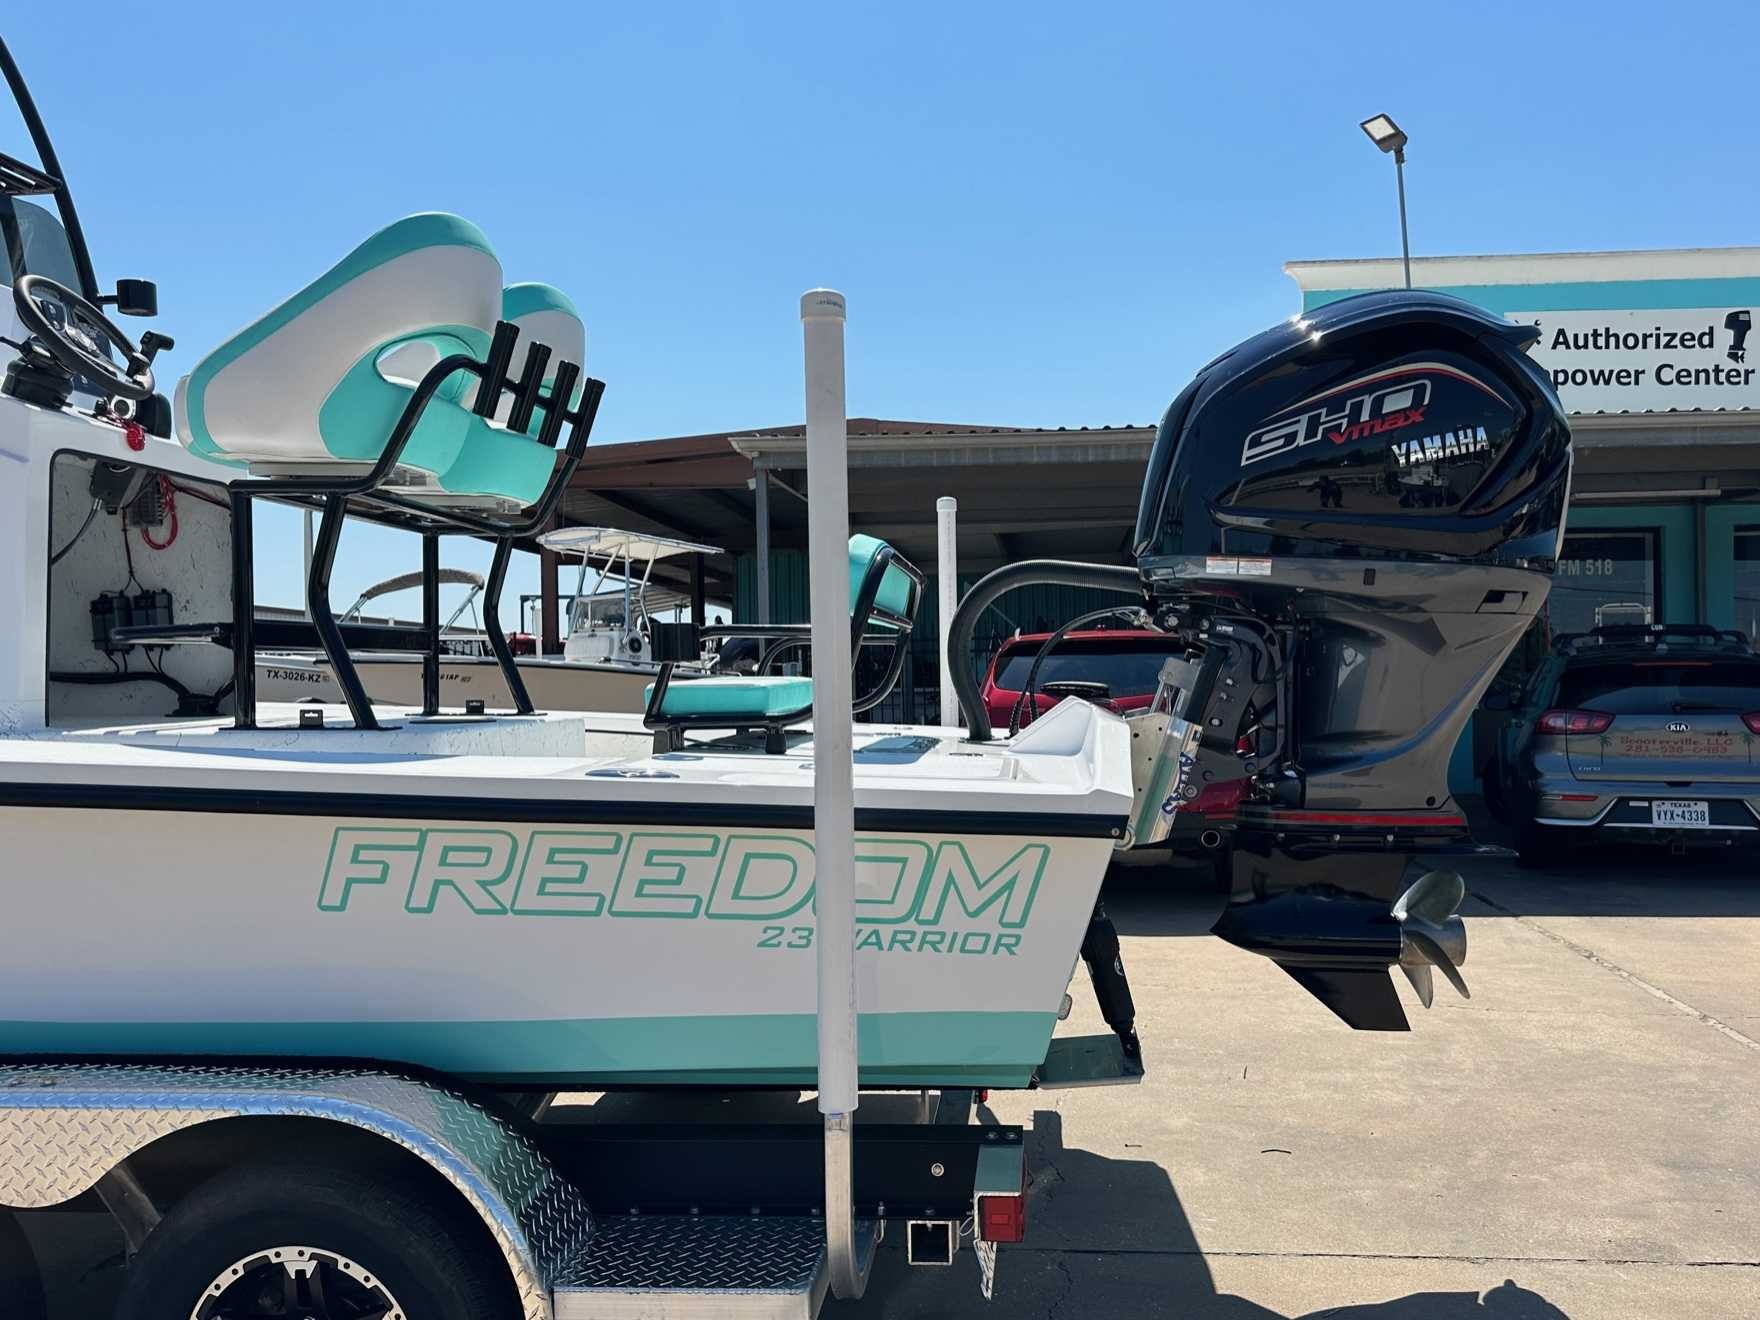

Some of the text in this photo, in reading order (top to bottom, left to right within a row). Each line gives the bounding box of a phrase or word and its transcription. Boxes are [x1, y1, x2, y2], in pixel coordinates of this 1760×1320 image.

[1551, 326, 1715, 350] Authorized
[1551, 363, 1756, 391] power Center
[1240, 379, 1432, 467] SHO
[1391, 424, 1490, 468] YAMAHA
[1558, 558, 1614, 576] FM 518
[1670, 723, 1687, 732] KIA
[318, 826, 1050, 928] FREEDOM
[756, 926, 1023, 956] 23 ARRIOR
